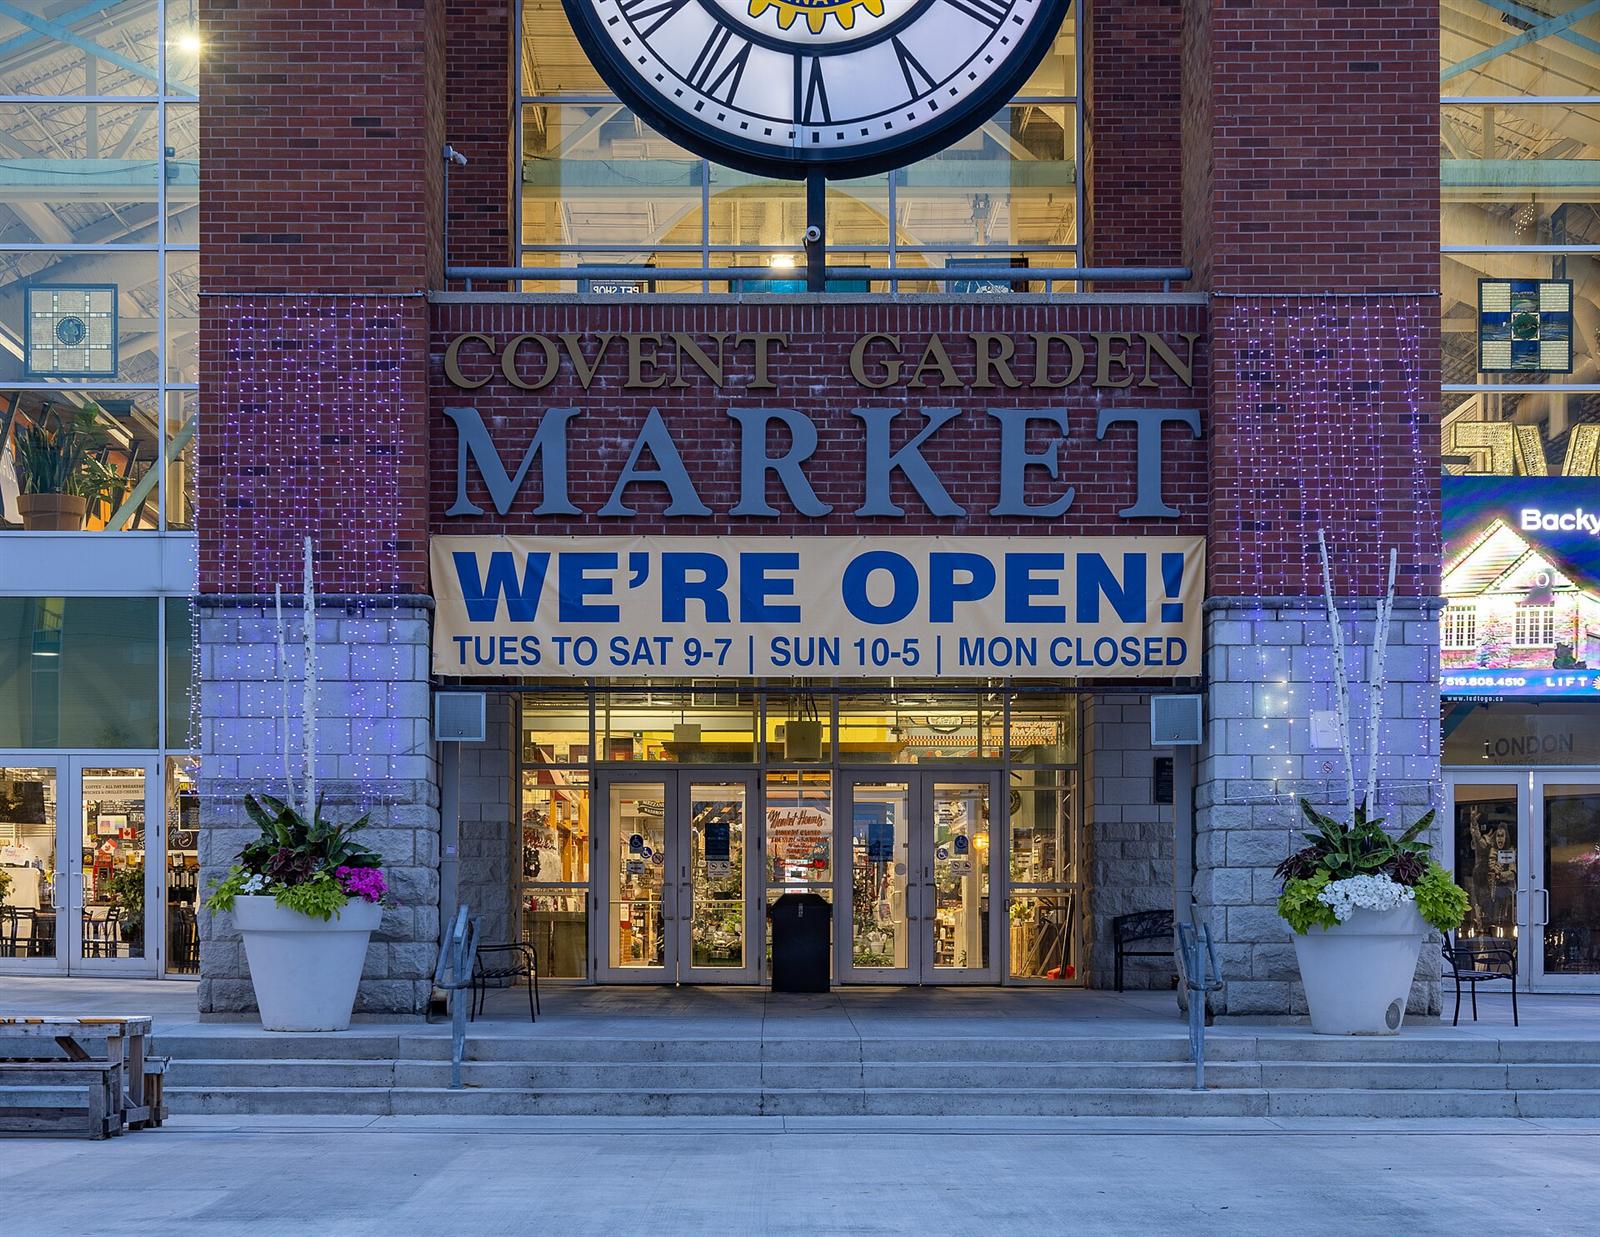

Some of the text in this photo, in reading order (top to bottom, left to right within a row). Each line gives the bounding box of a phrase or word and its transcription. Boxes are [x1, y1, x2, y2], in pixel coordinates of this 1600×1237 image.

[444, 332, 1201, 389] COVENT GARDEN
[442, 405, 1202, 517] MARKET
[453, 550, 1184, 624] WE'RE OPEN!
[454, 636, 1187, 667] TUES TO SAT 9-7 SUN 10-5 MON CLOSED
[1546, 677, 1588, 686] LIFT
[1485, 733, 1574, 756] LONDON
